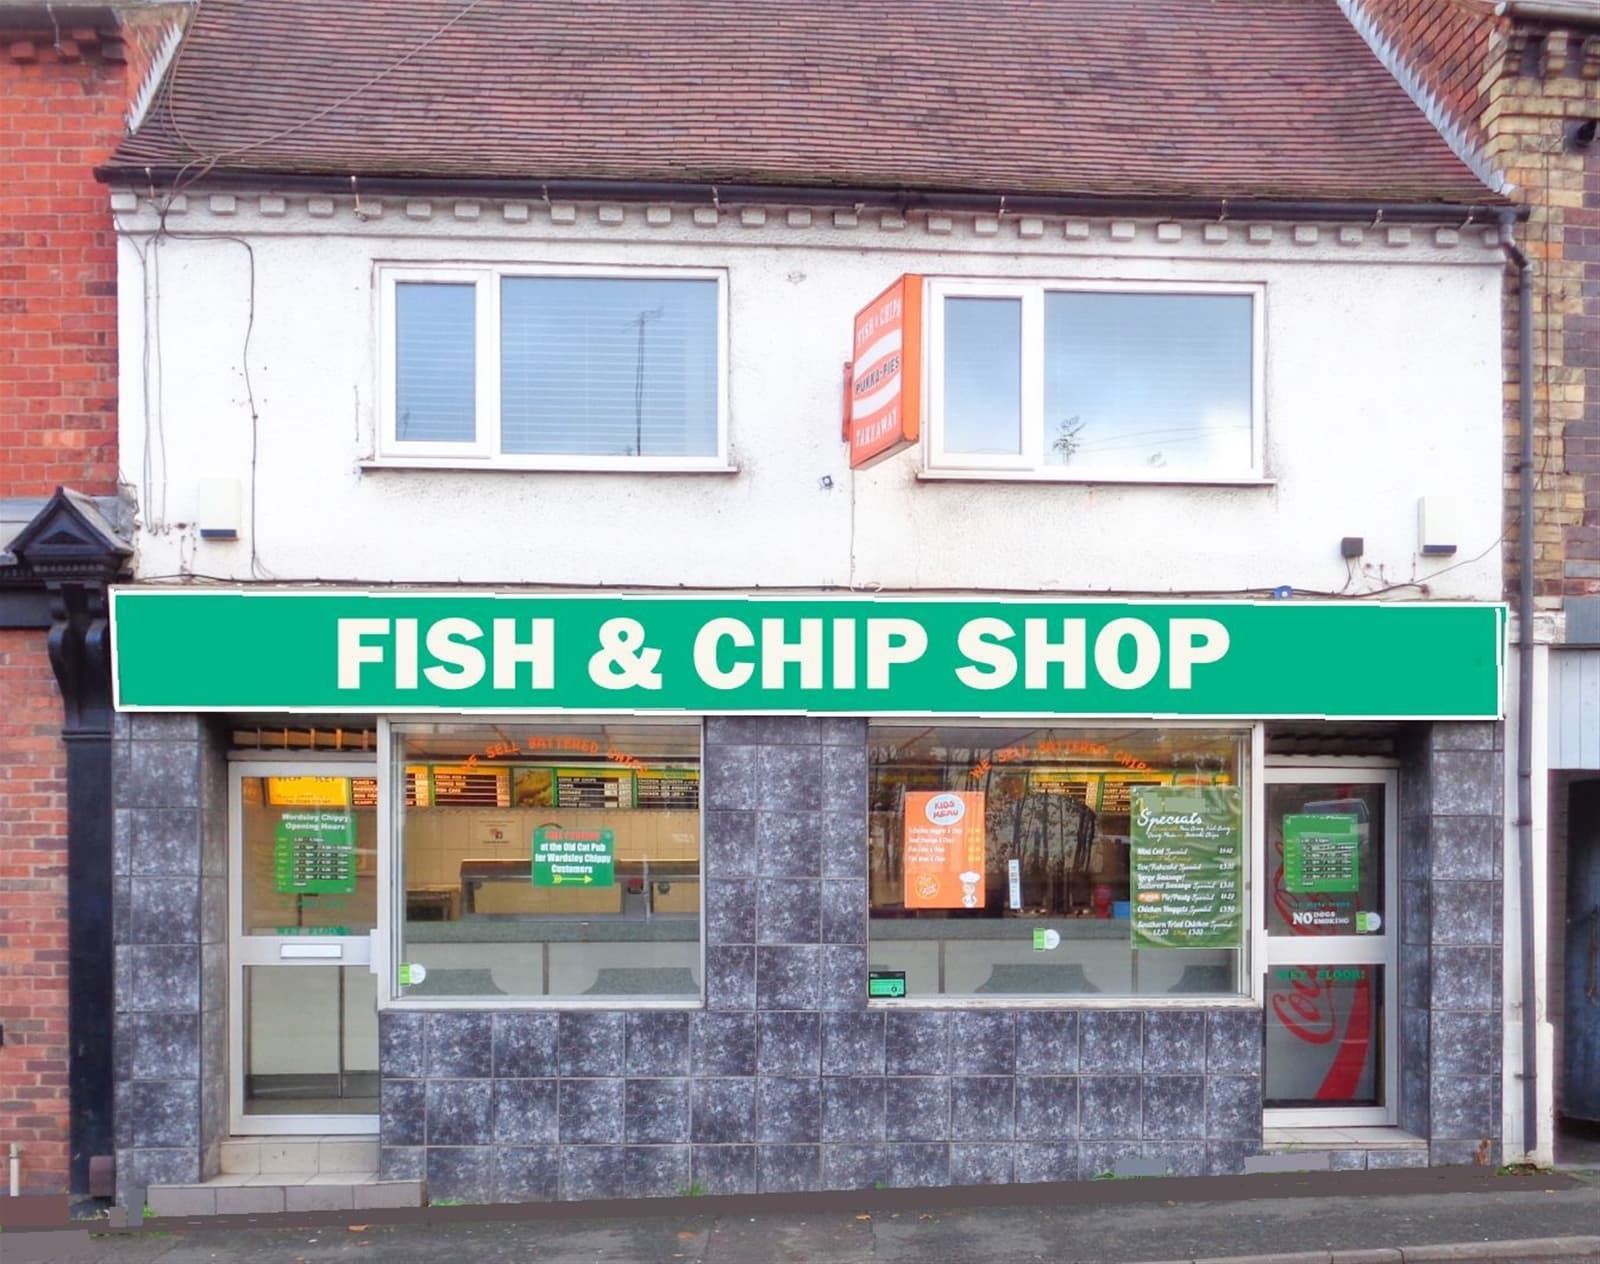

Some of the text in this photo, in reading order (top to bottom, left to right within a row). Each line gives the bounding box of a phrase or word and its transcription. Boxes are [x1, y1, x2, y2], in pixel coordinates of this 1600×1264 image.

[338, 618, 1229, 689] FISH & CHIP SHOP
[1137, 808, 1203, 835] Specials
[1292, 912, 1313, 925] NO
